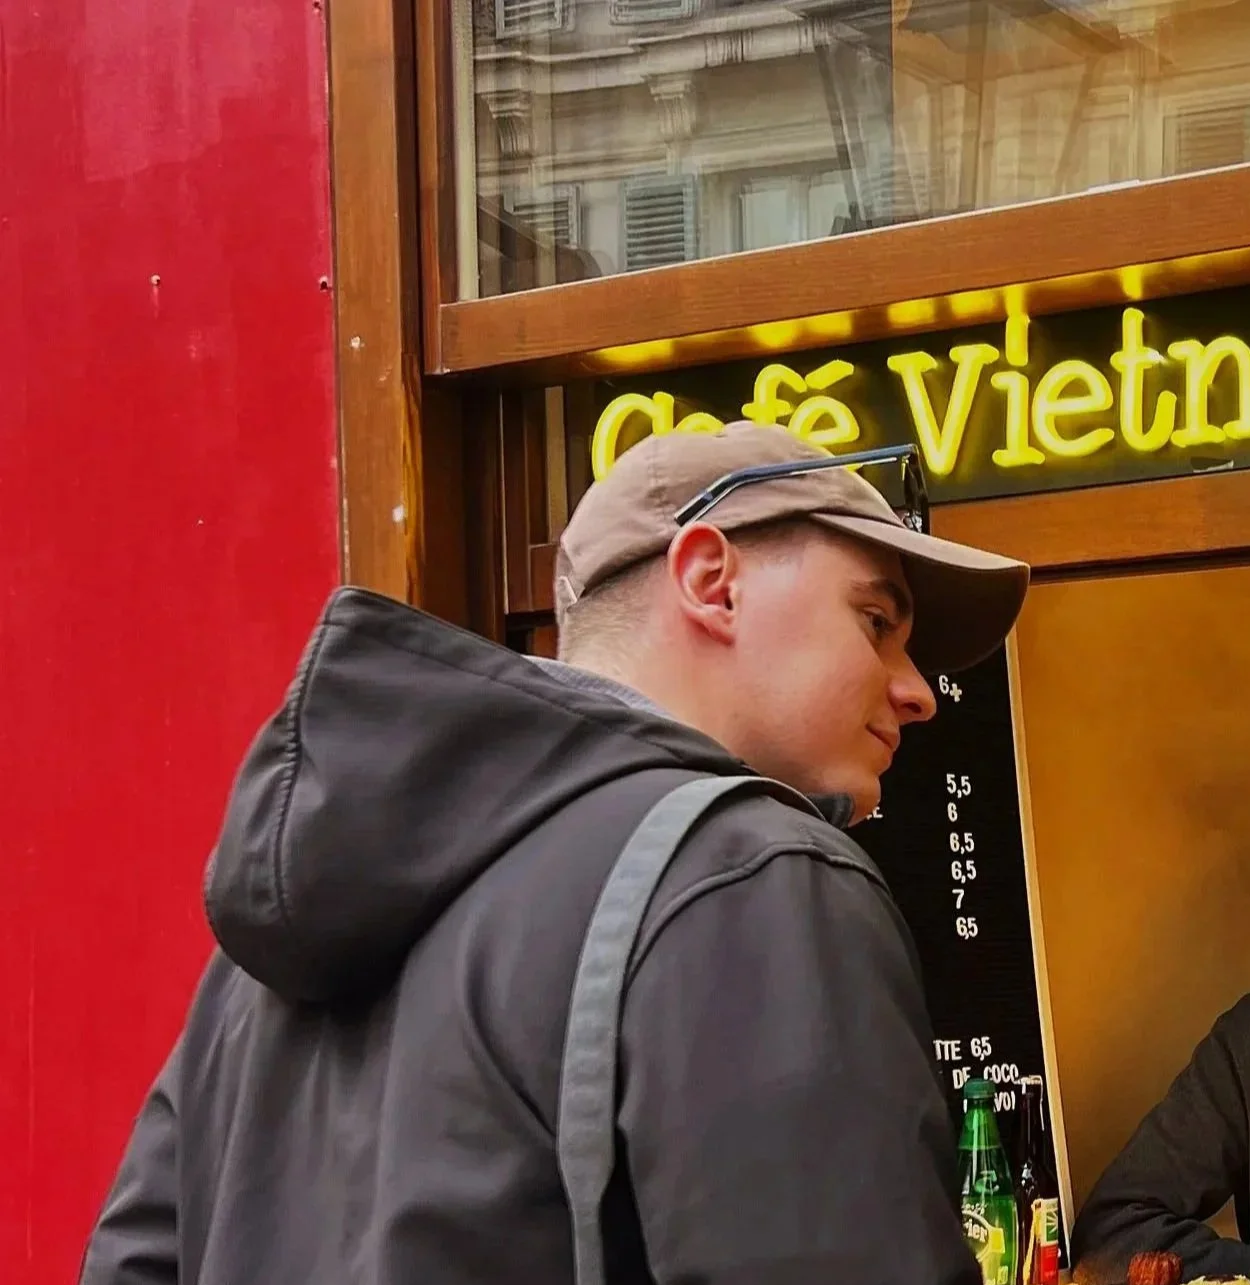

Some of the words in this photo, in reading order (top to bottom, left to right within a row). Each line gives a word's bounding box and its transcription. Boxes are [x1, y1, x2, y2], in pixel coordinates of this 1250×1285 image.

[591, 359, 865, 482] Cfé
[946, 773, 971, 798] 5,5
[947, 802, 958, 822] 6
[949, 832, 975, 854] 6,5
[951, 860, 977, 883] 6,5
[952, 889, 965, 909] 7
[956, 917, 978, 940] 6,5
[970, 1036, 992, 1061] 6,5
